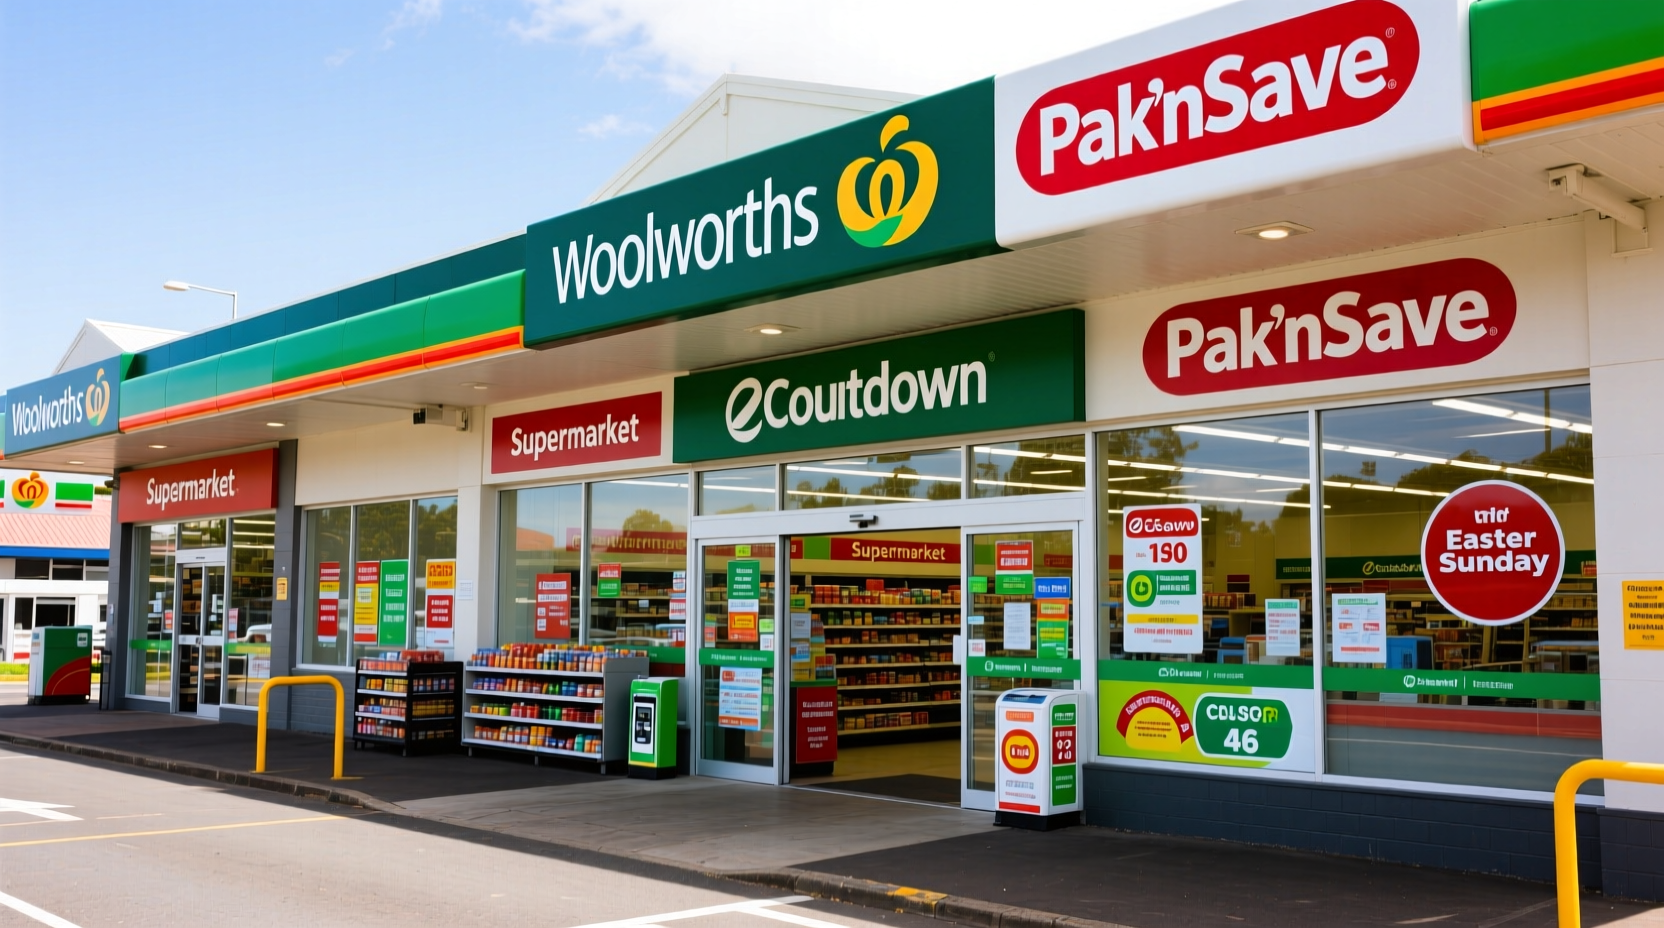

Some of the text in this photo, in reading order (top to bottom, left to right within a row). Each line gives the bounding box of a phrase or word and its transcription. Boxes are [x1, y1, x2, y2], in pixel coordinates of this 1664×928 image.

[552, 176, 819, 304] Woolworths
[12, 385, 84, 437] Woolworths
[510, 413, 640, 462] Supermarket
[146, 469, 236, 511] Supermarket
[851, 541, 946, 562] Supermarket
[1446, 529, 1537, 550] Easter
[1439, 550, 1550, 577] Sunday
[1223, 728, 1259, 754] 46
